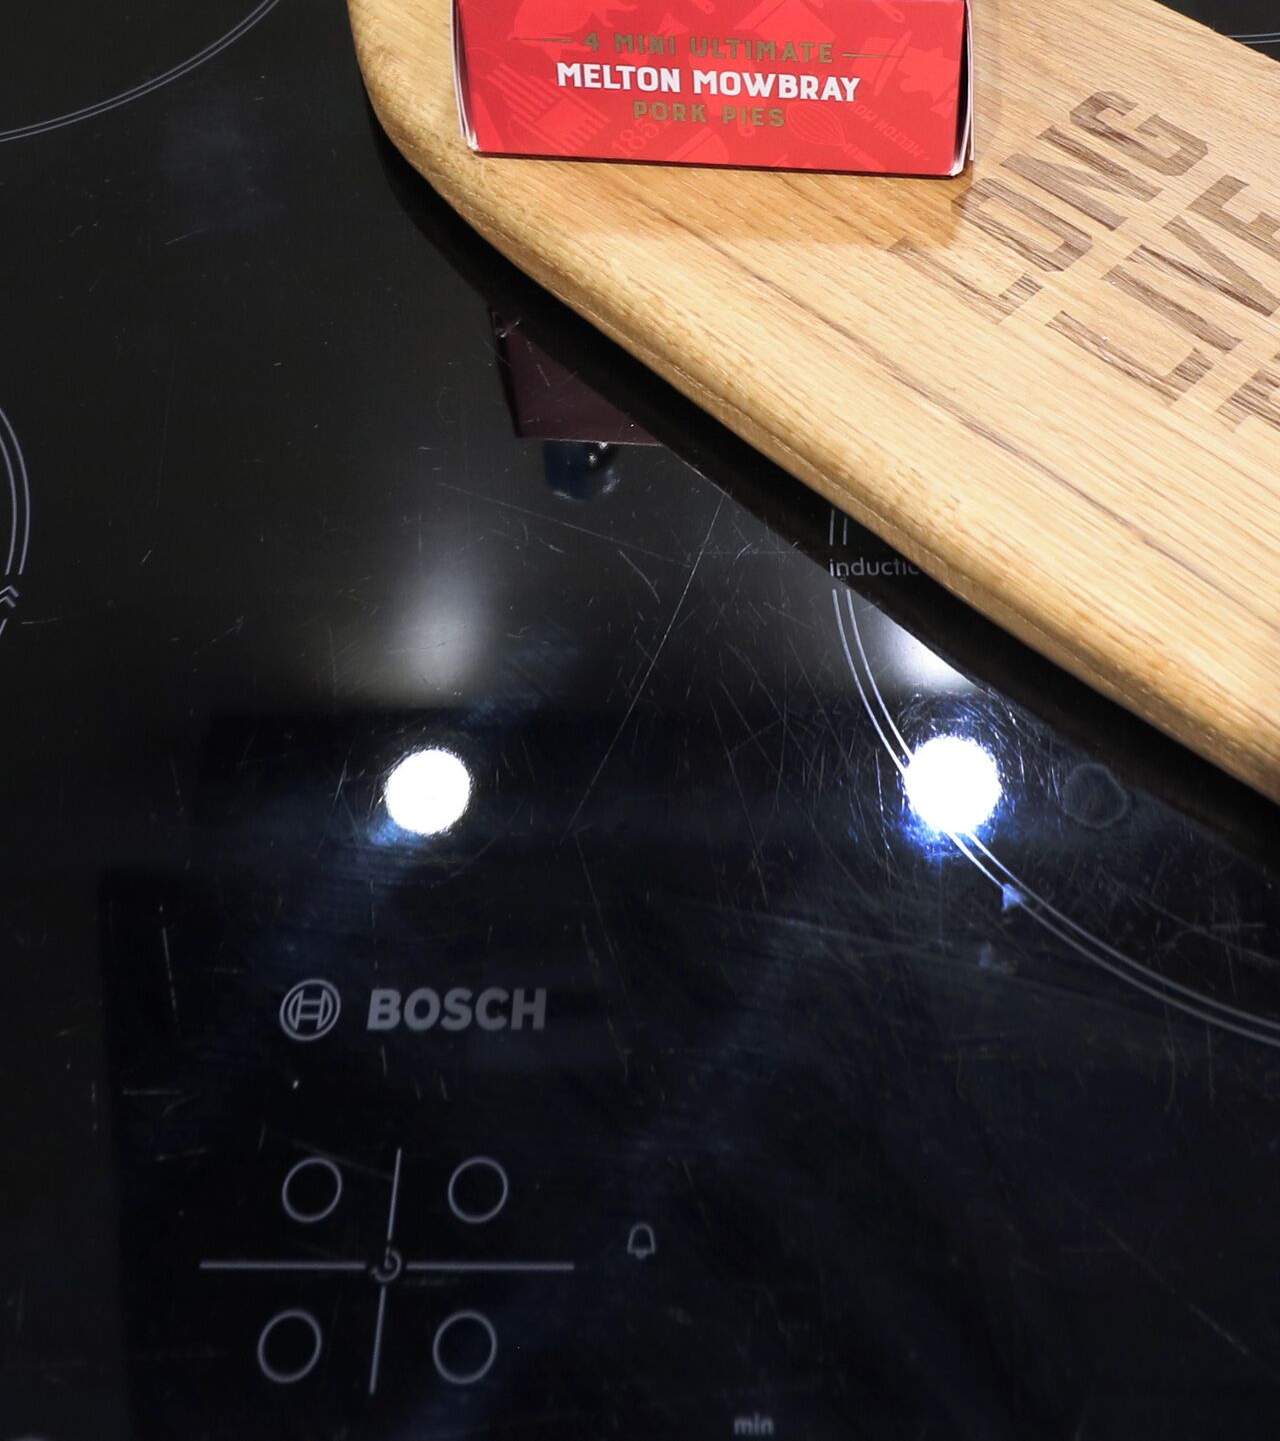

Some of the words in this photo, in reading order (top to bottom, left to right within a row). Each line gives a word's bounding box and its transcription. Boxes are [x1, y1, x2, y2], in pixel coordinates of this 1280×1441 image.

[583, 32, 600, 52] 4
[614, 33, 676, 56] MINI
[690, 36, 833, 64] ULTIMATE
[556, 62, 681, 93] MELTON
[692, 69, 861, 102] MOWBRAY
[633, 100, 708, 124] PORK
[722, 105, 786, 128] PIES
[886, 91, 1209, 325] LONG
[829, 557, 919, 577] inductio
[366, 987, 548, 1031] BOSCH
[734, 1414, 774, 1436] min
